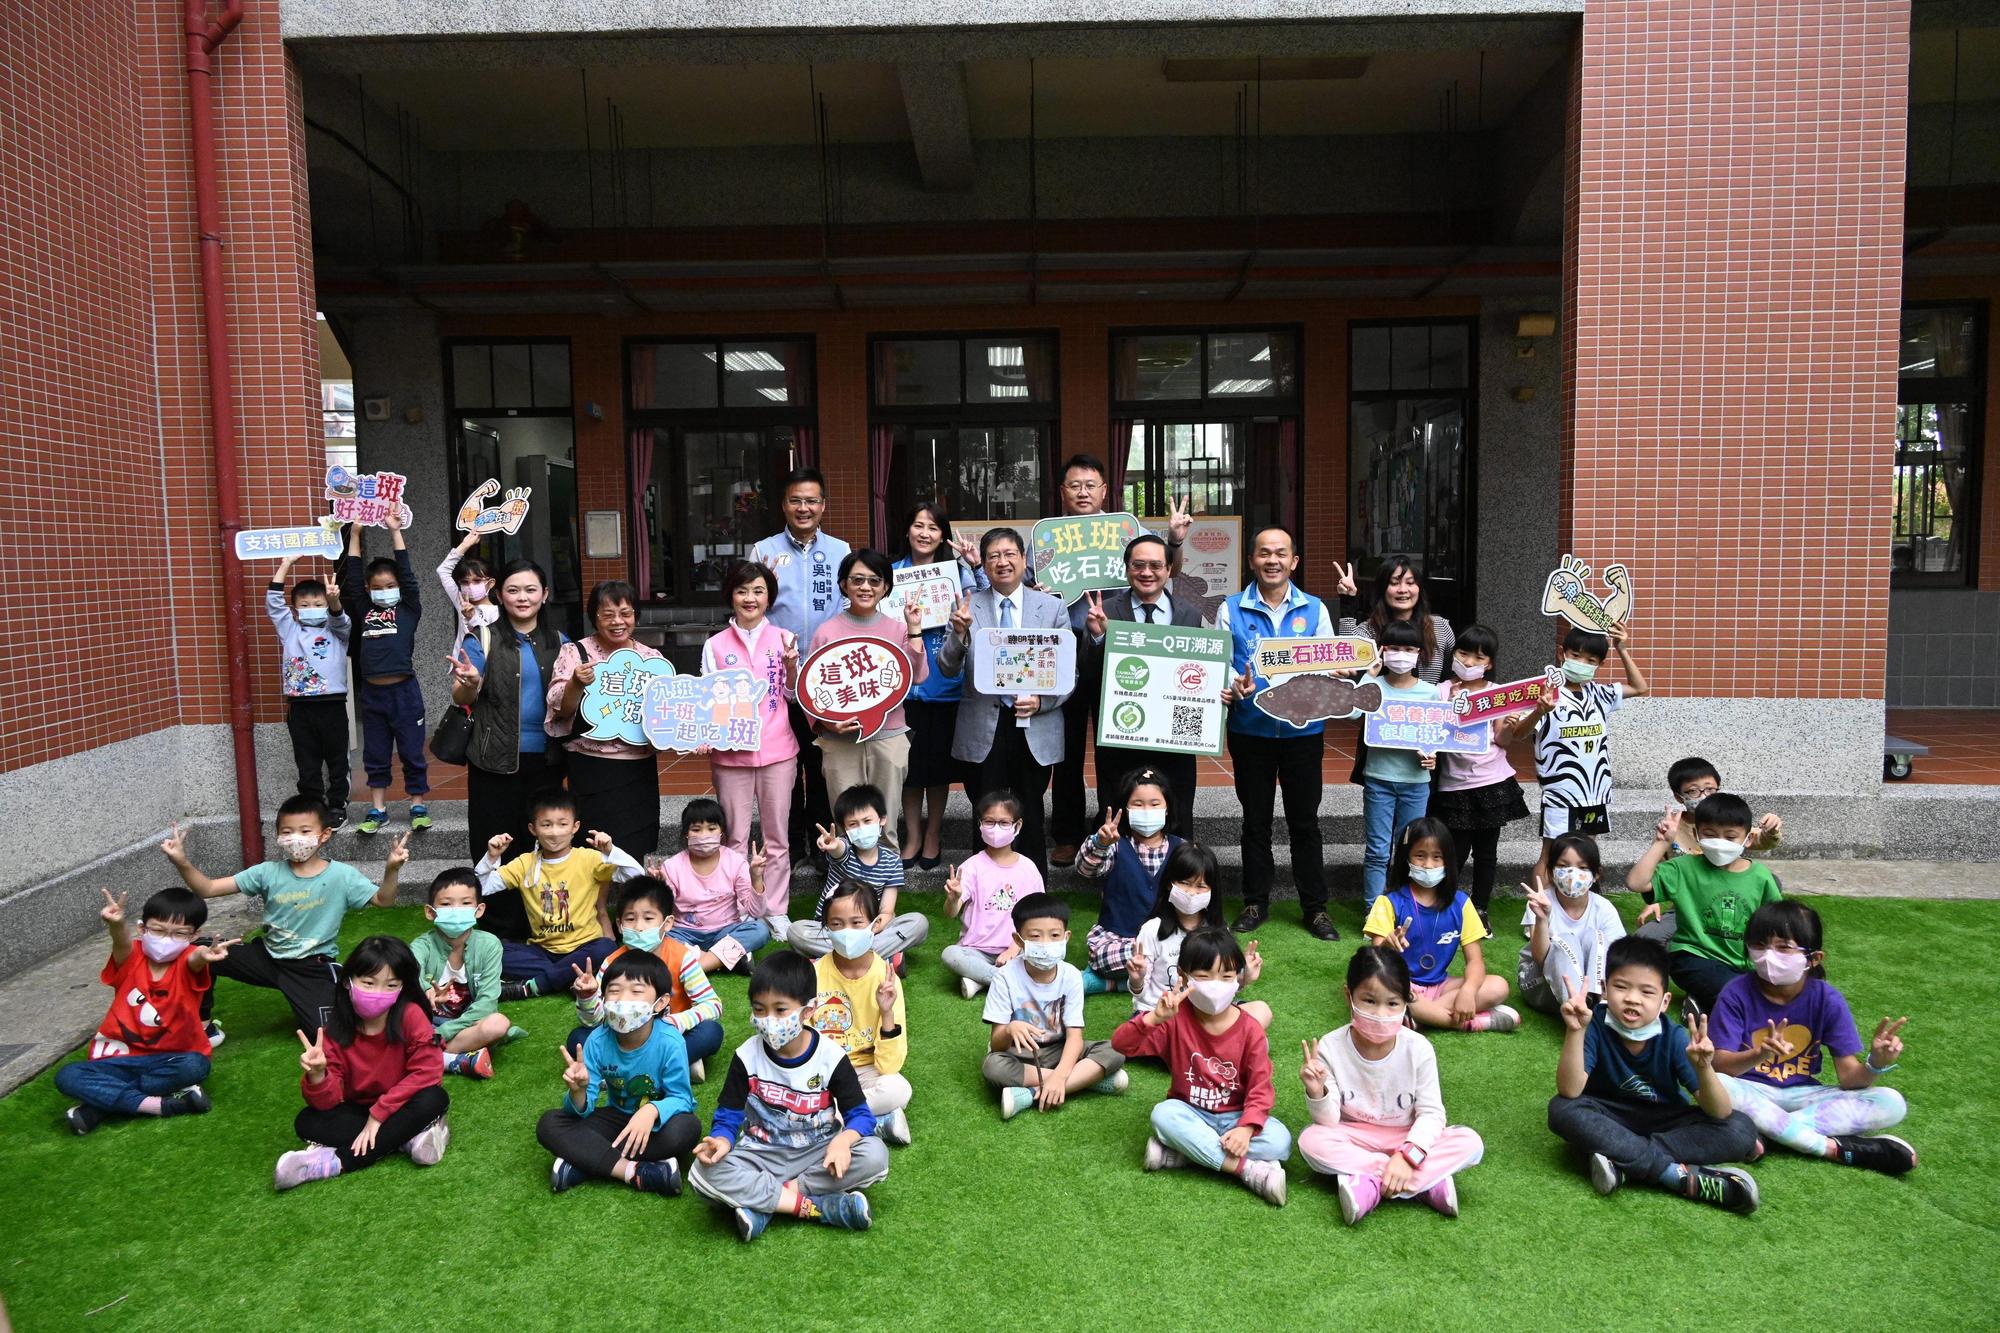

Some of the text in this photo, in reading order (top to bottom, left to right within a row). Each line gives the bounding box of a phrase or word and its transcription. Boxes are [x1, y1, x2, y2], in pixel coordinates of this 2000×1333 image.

[244, 530, 338, 551] 支持國產魚
[1052, 521, 1120, 553] 班班
[1049, 556, 1127, 584] 吃石斑
[812, 564, 825, 611] 吳旭智
[1114, 631, 1224, 655] 三章一Q可溯源
[1261, 641, 1355, 666] 我是石斑魚
[819, 645, 878, 685] 這斑
[652, 680, 694, 701] 九班
[836, 678, 880, 708] 美味
[1475, 683, 1541, 712] 我愛吃魚
[656, 701, 696, 721] 十班
[1584, 740, 1594, 753] 19
[1584, 812, 1596, 823] 19
[1190, 1085, 1230, 1099] HELLO
[1190, 1096, 1230, 1110] KITTY
